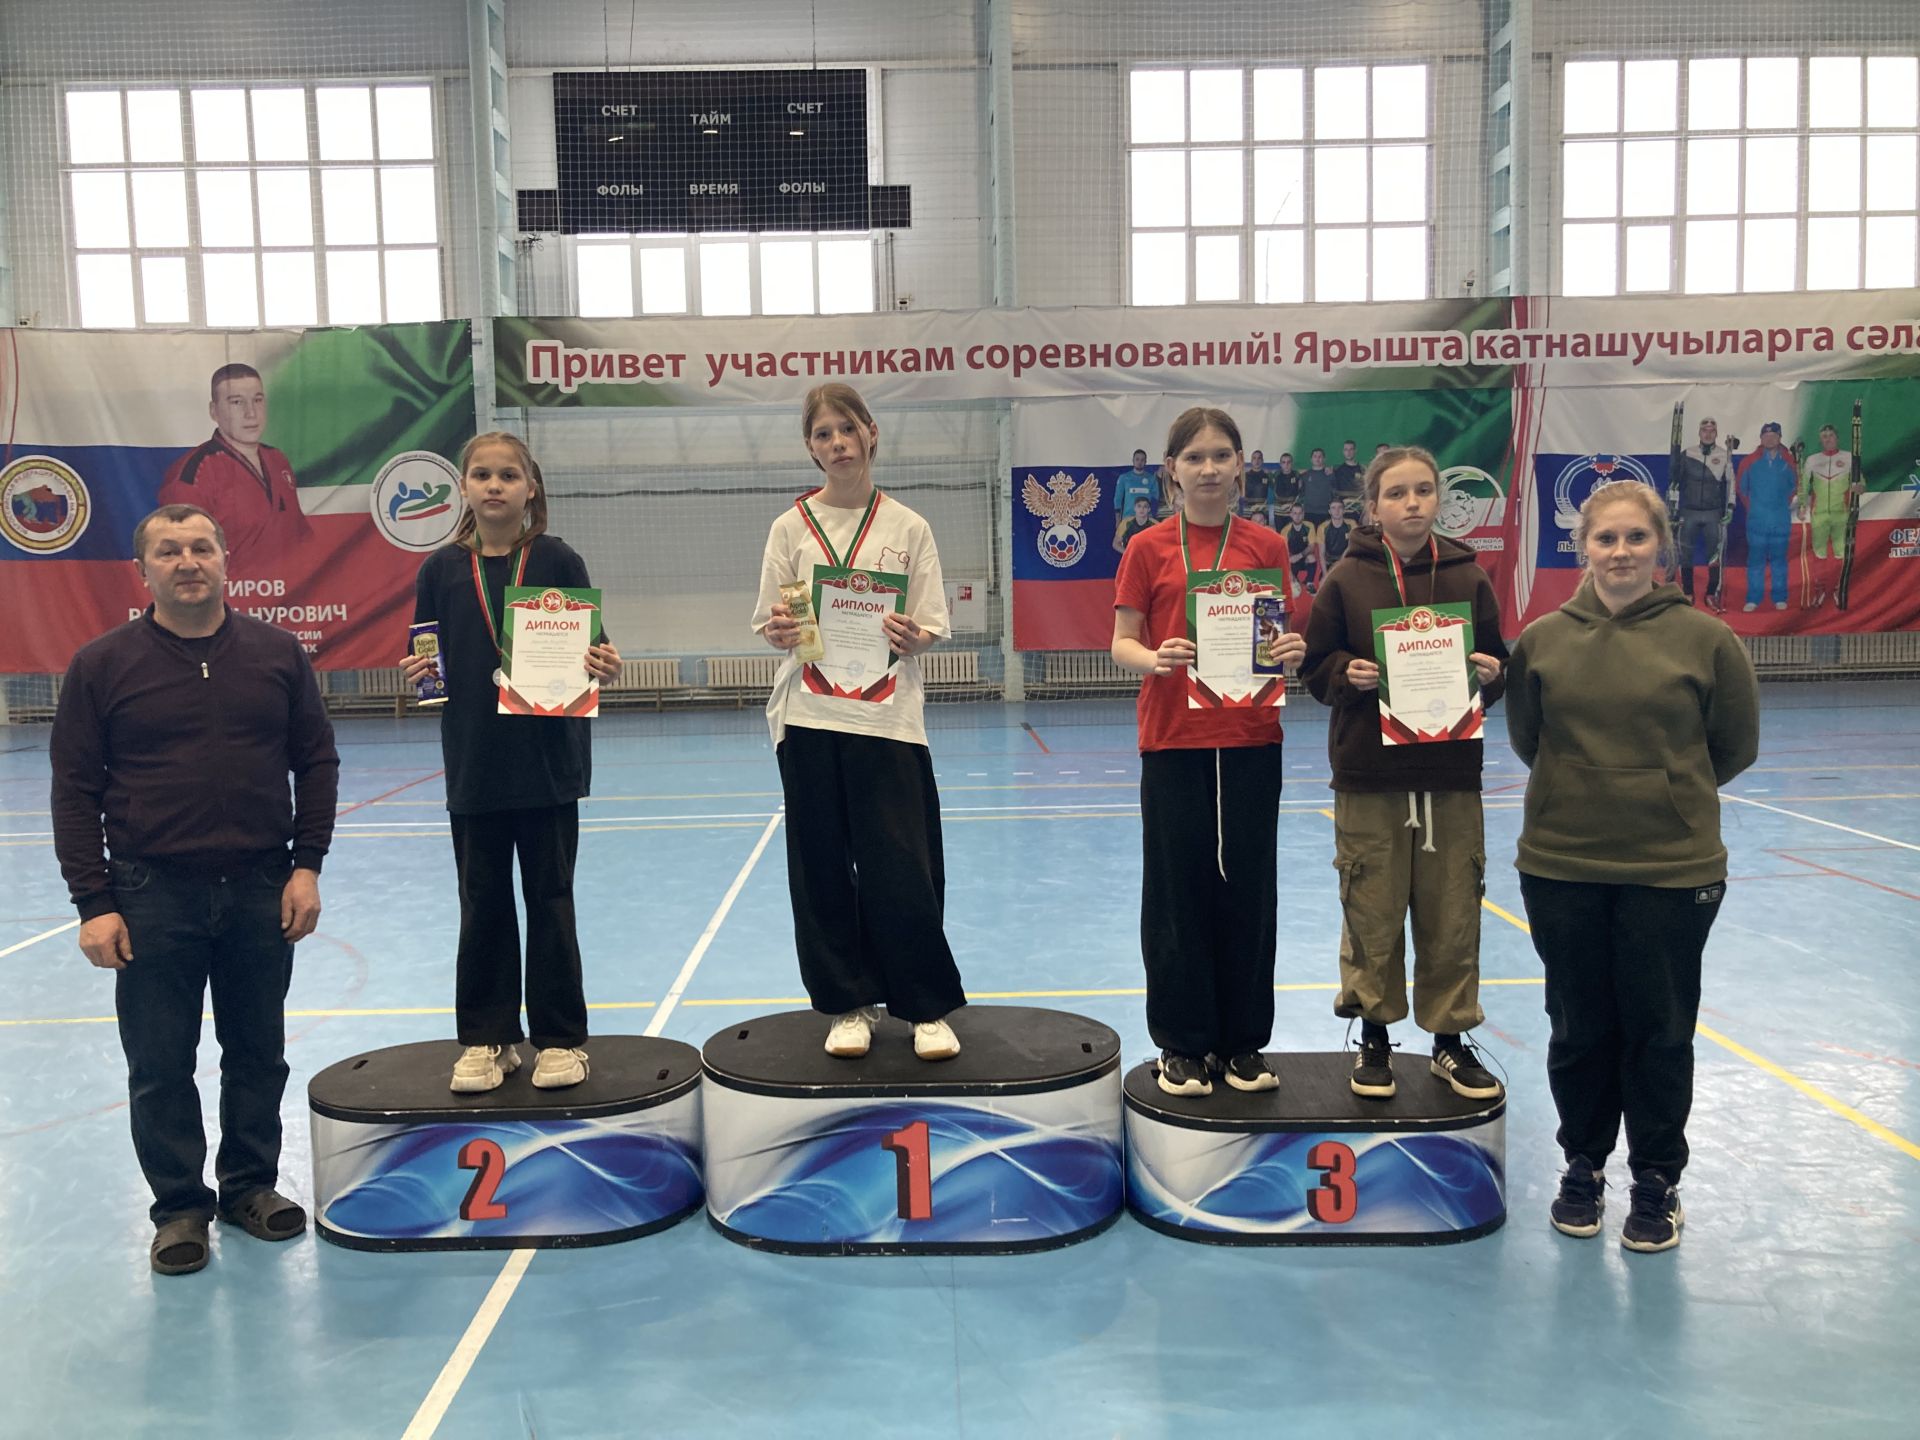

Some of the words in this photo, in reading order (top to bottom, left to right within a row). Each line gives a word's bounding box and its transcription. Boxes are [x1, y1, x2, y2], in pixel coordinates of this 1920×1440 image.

[601, 104, 638, 117] СЧЕТ
[786, 102, 824, 115] СЧЕТ
[689, 110, 732, 126] ТАЙМ
[596, 184, 644, 196] ФОЛЫ
[689, 183, 739, 195] ВРЕМЯ
[778, 181, 826, 195] ФОЛЫ
[531, 345, 687, 387] Привет
[706, 346, 955, 387] участникам
[965, 331, 1283, 378] соревнований!
[1293, 331, 1464, 373] Ярышта
[1476, 326, 1834, 366] катнашучыларга
[1846, 324, 1920, 351] сәл
[831, 598, 885, 614] ДИПЛОМ
[525, 620, 580, 631] ДИПЛОМ
[416, 639, 437, 648] Alpen
[418, 645, 436, 654] Gold
[1397, 638, 1453, 654] ДИПЛОМ
[881, 1121, 933, 1221] 1
[458, 1138, 507, 1221] 2
[1306, 1140, 1358, 1224] 3
